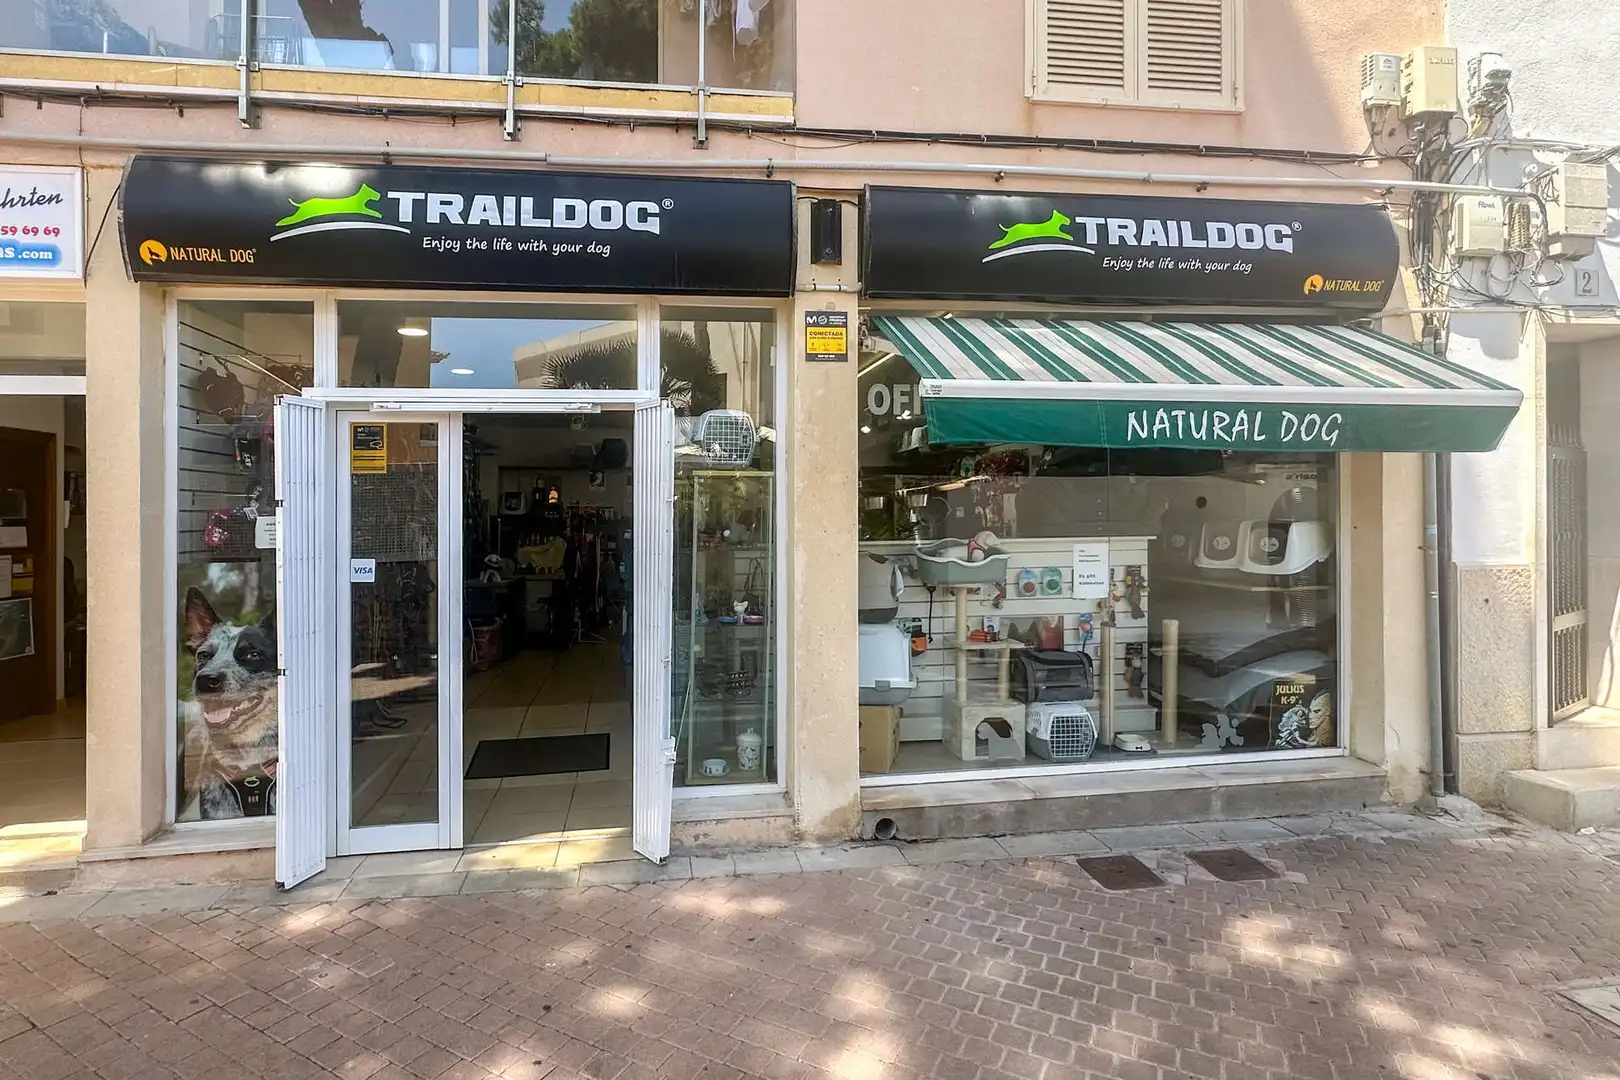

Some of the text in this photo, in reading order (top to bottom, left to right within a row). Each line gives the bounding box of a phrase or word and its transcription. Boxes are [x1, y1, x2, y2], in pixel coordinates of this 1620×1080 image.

[22, 225, 39, 237] 69
[43, 226, 60, 237] 69
[169, 246, 227, 263] NATURAL
[422, 236, 611, 257] Enjoy the life with your dog
[1102, 256, 1252, 275] Enjoy the life with your dog
[1323, 279, 1361, 292] NATURAL
[1582, 271, 1592, 294] 2
[1127, 408, 1342, 447] NATURAL DOG
[353, 566, 373, 575] VISA
[1275, 684, 1305, 696] JULIUS
